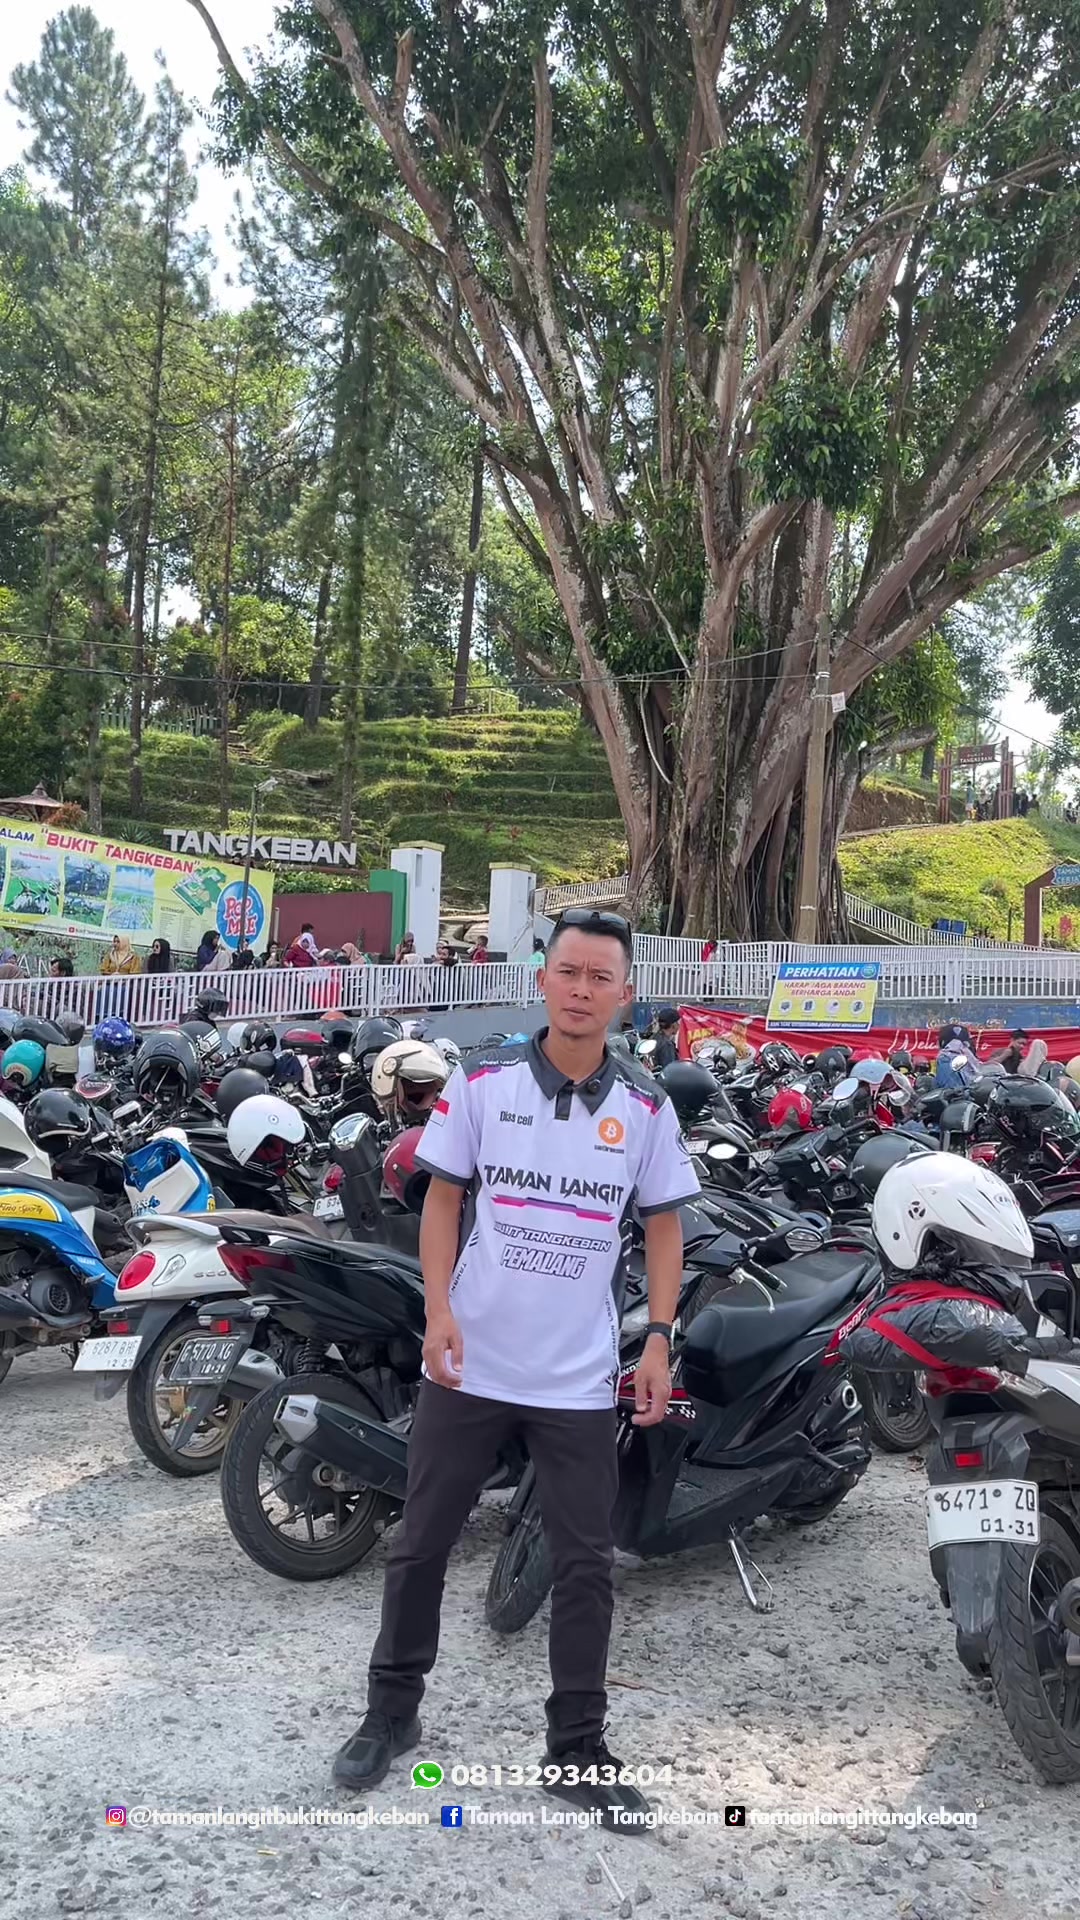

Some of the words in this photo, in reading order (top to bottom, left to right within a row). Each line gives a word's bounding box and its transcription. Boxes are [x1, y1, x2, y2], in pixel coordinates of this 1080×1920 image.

[163, 828, 357, 865] TANGKEBAN
[225, 912, 258, 937] ME
[784, 966, 860, 978] PERHATIAN
[484, 1164, 551, 1193] TAMAN
[560, 1176, 624, 1205] LANGIT
[500, 1244, 588, 1280] PEMALANG
[940, 1488, 989, 1512] 6471
[1014, 1487, 1036, 1511] ZQ
